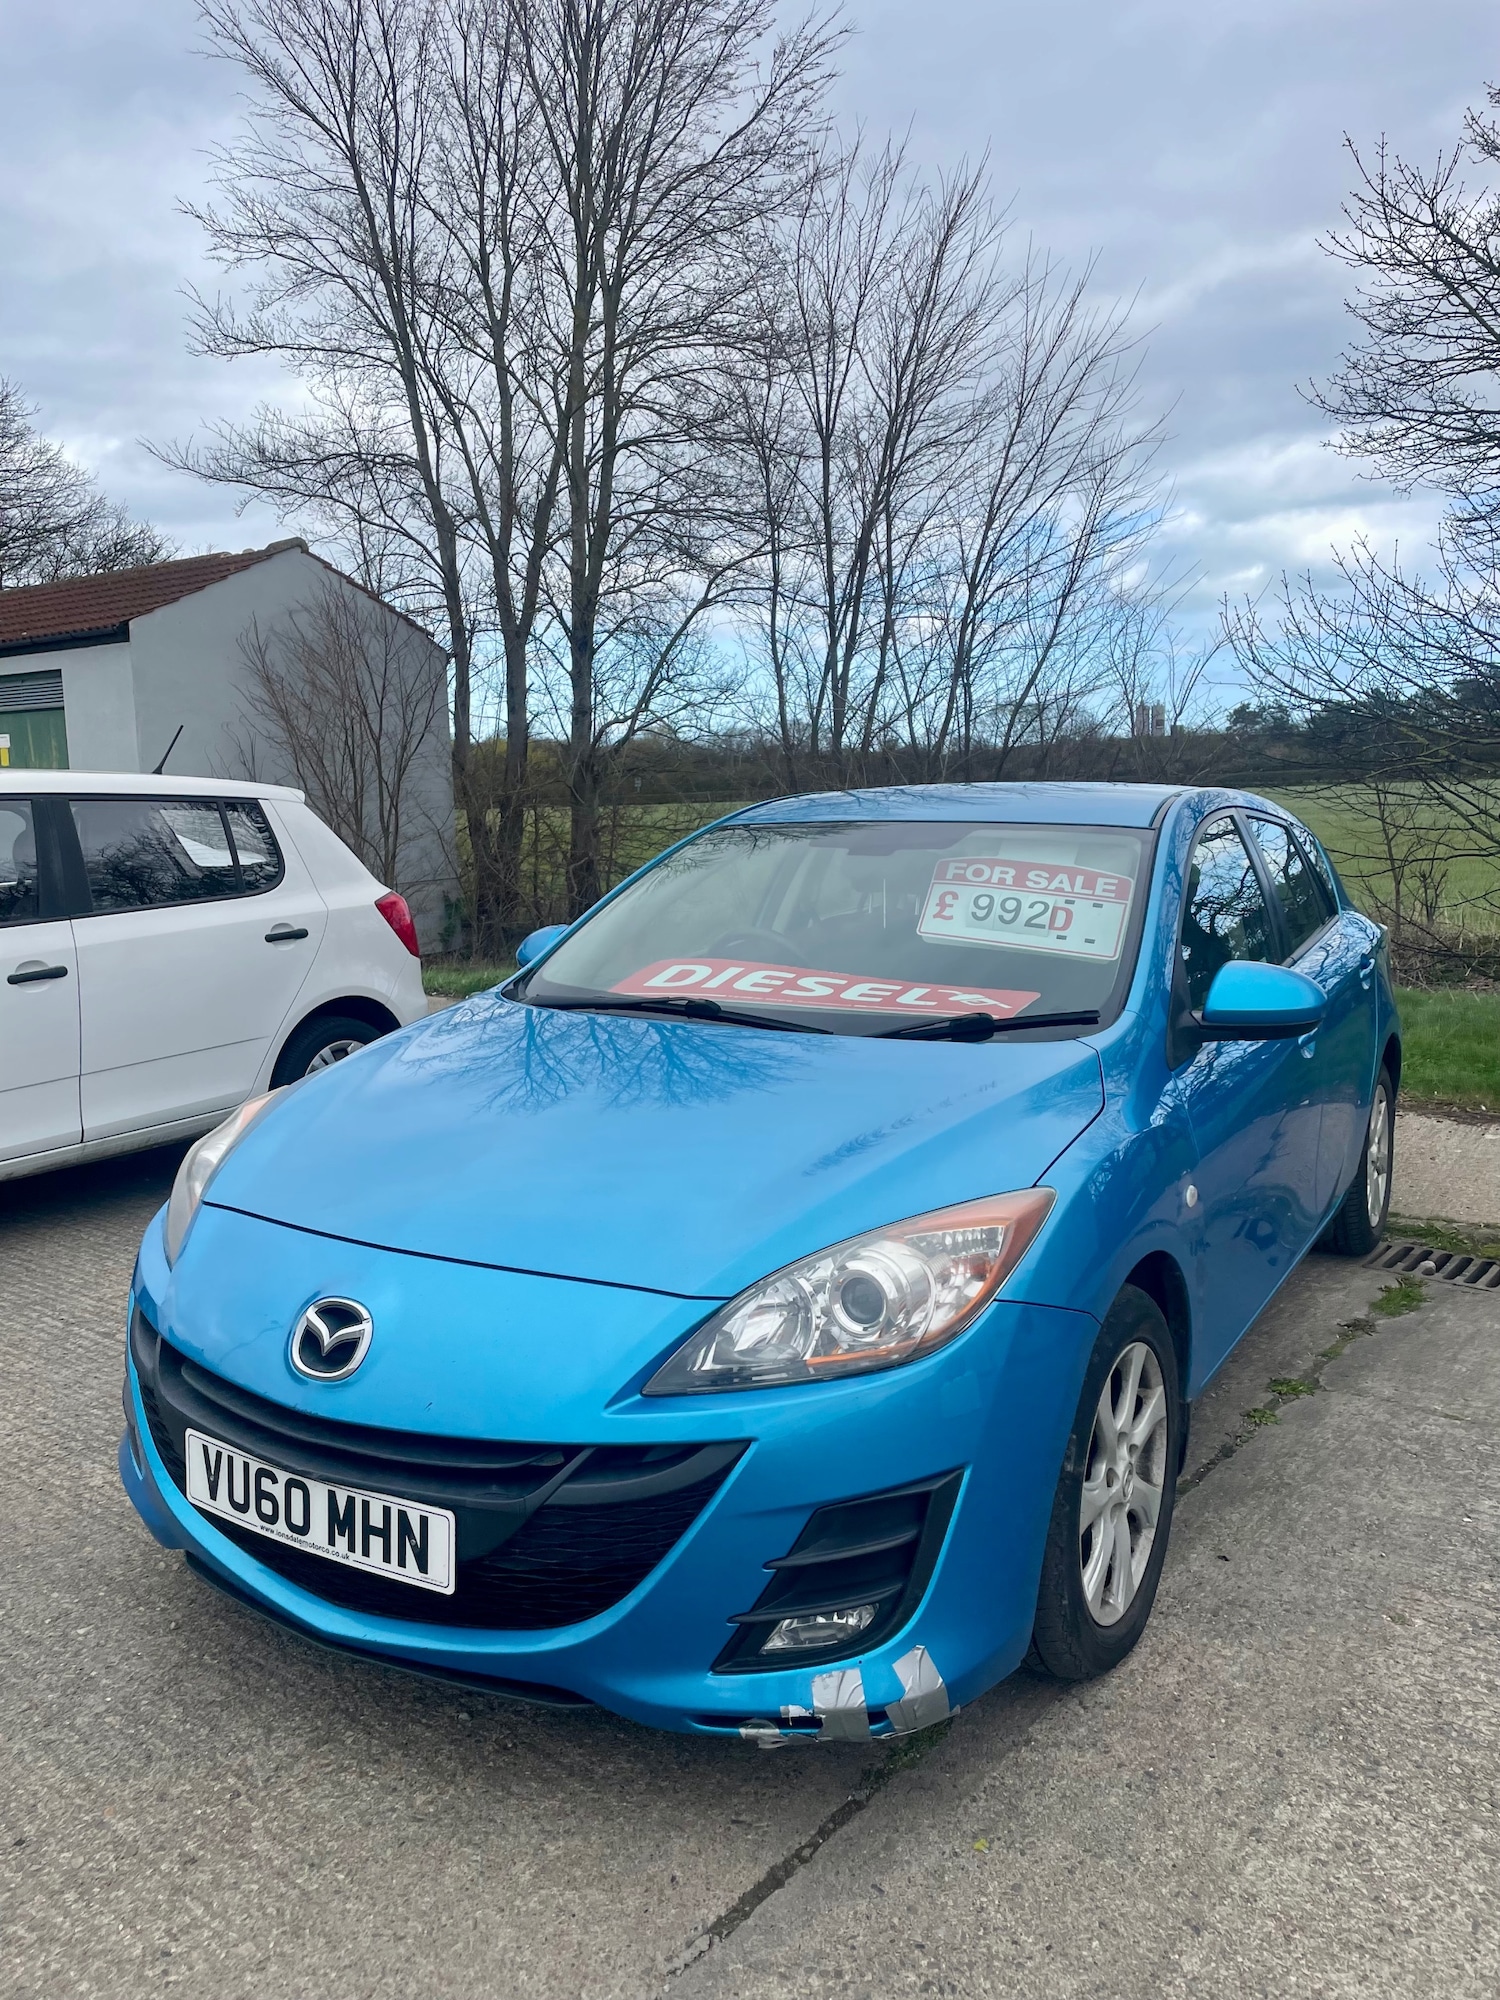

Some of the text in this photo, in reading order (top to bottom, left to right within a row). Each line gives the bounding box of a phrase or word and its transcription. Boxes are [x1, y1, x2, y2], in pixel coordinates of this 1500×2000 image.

[946, 862, 1119, 897] FOR SALE
[643, 964, 939, 1007] DIESEL
[202, 1443, 429, 1575] VU60 MHN
